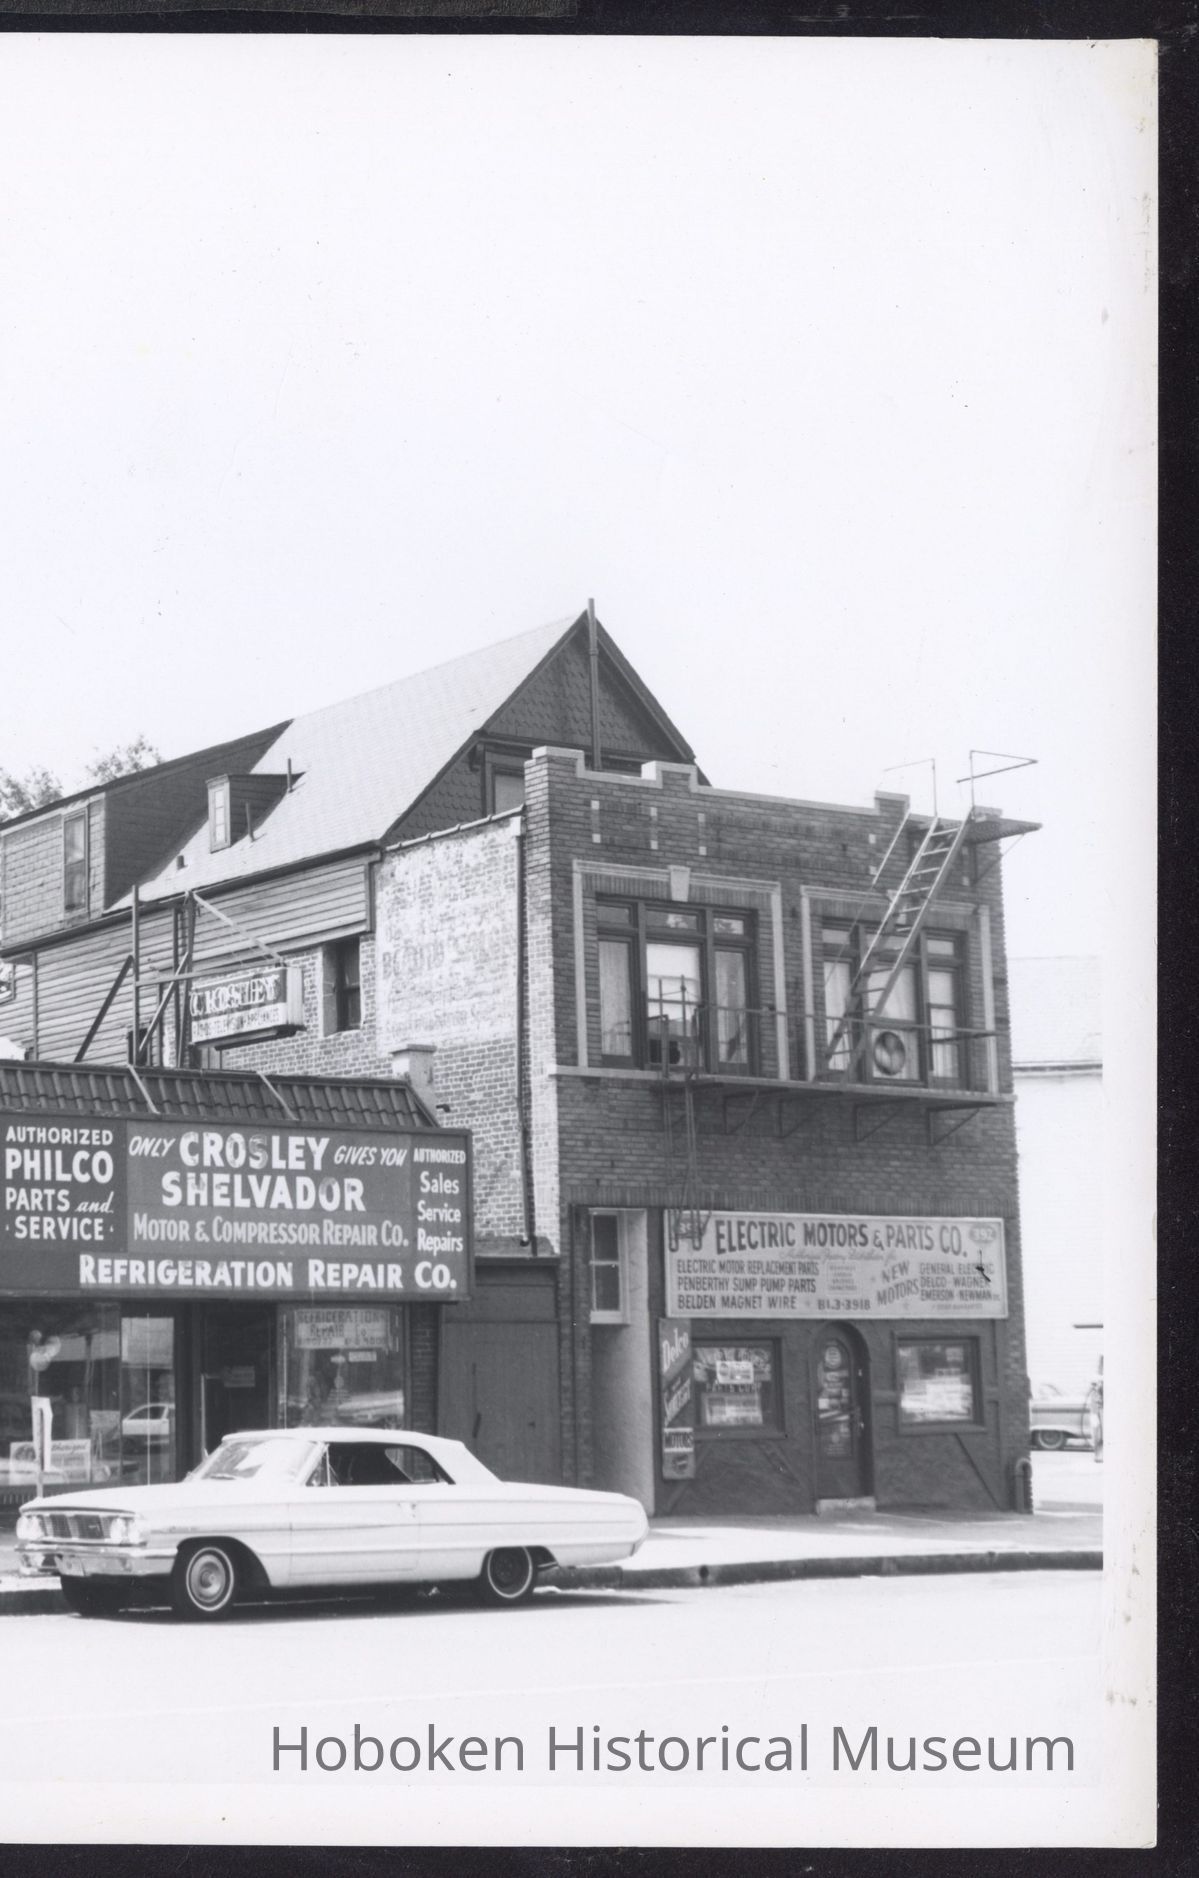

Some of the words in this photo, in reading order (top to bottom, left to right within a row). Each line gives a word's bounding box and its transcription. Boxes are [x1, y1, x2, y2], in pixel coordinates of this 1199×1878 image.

[6, 1126, 114, 1145] AUTHORIZED
[128, 1136, 176, 1158] ONLY
[179, 1132, 329, 1171] CROSLEY
[333, 1145, 377, 1165] GIVES
[380, 1148, 407, 1167] YOU
[413, 1148, 466, 1164] AUTHORIZED
[5, 1148, 114, 1184] PHILCO
[161, 1172, 366, 1211] SHELVADOR
[420, 1171, 460, 1194] Sales
[5, 1188, 70, 1212] PARTS
[75, 1192, 114, 1215] and
[417, 1201, 462, 1223] Service
[14, 1216, 104, 1241] SERVICE
[195, 1222, 209, 1242] &
[715, 1220, 796, 1255] ELECTRIC
[803, 1222, 869, 1249] MOTORS
[873, 1230, 884, 1250] &
[886, 1224, 934, 1250] PARTS
[939, 1225, 967, 1257] CO.
[417, 1229, 464, 1255] Repairs
[79, 1254, 293, 1288] REFRIGERATION
[308, 1259, 404, 1288] REPAIR
[677, 1259, 716, 1274] ELECTRIC
[719, 1260, 745, 1274] MOTOR
[747, 1260, 797, 1275] REPLACEMENT
[798, 1262, 819, 1276] PARTS
[881, 1261, 909, 1283] NEW
[920, 1263, 954, 1274] GENERAL
[733, 1278, 757, 1291] SUMP
[761, 1278, 785, 1292] PUMP
[789, 1279, 816, 1293] PARTS
[877, 1278, 919, 1306] MOTORS
[920, 1276, 946, 1287] DELCO
[678, 1295, 716, 1309] BELDEN
[721, 1296, 762, 1309] MAGNET
[767, 1296, 797, 1309] WIRE
[921, 1289, 954, 1301] EMERSON
[662, 1328, 689, 1374] Delco
